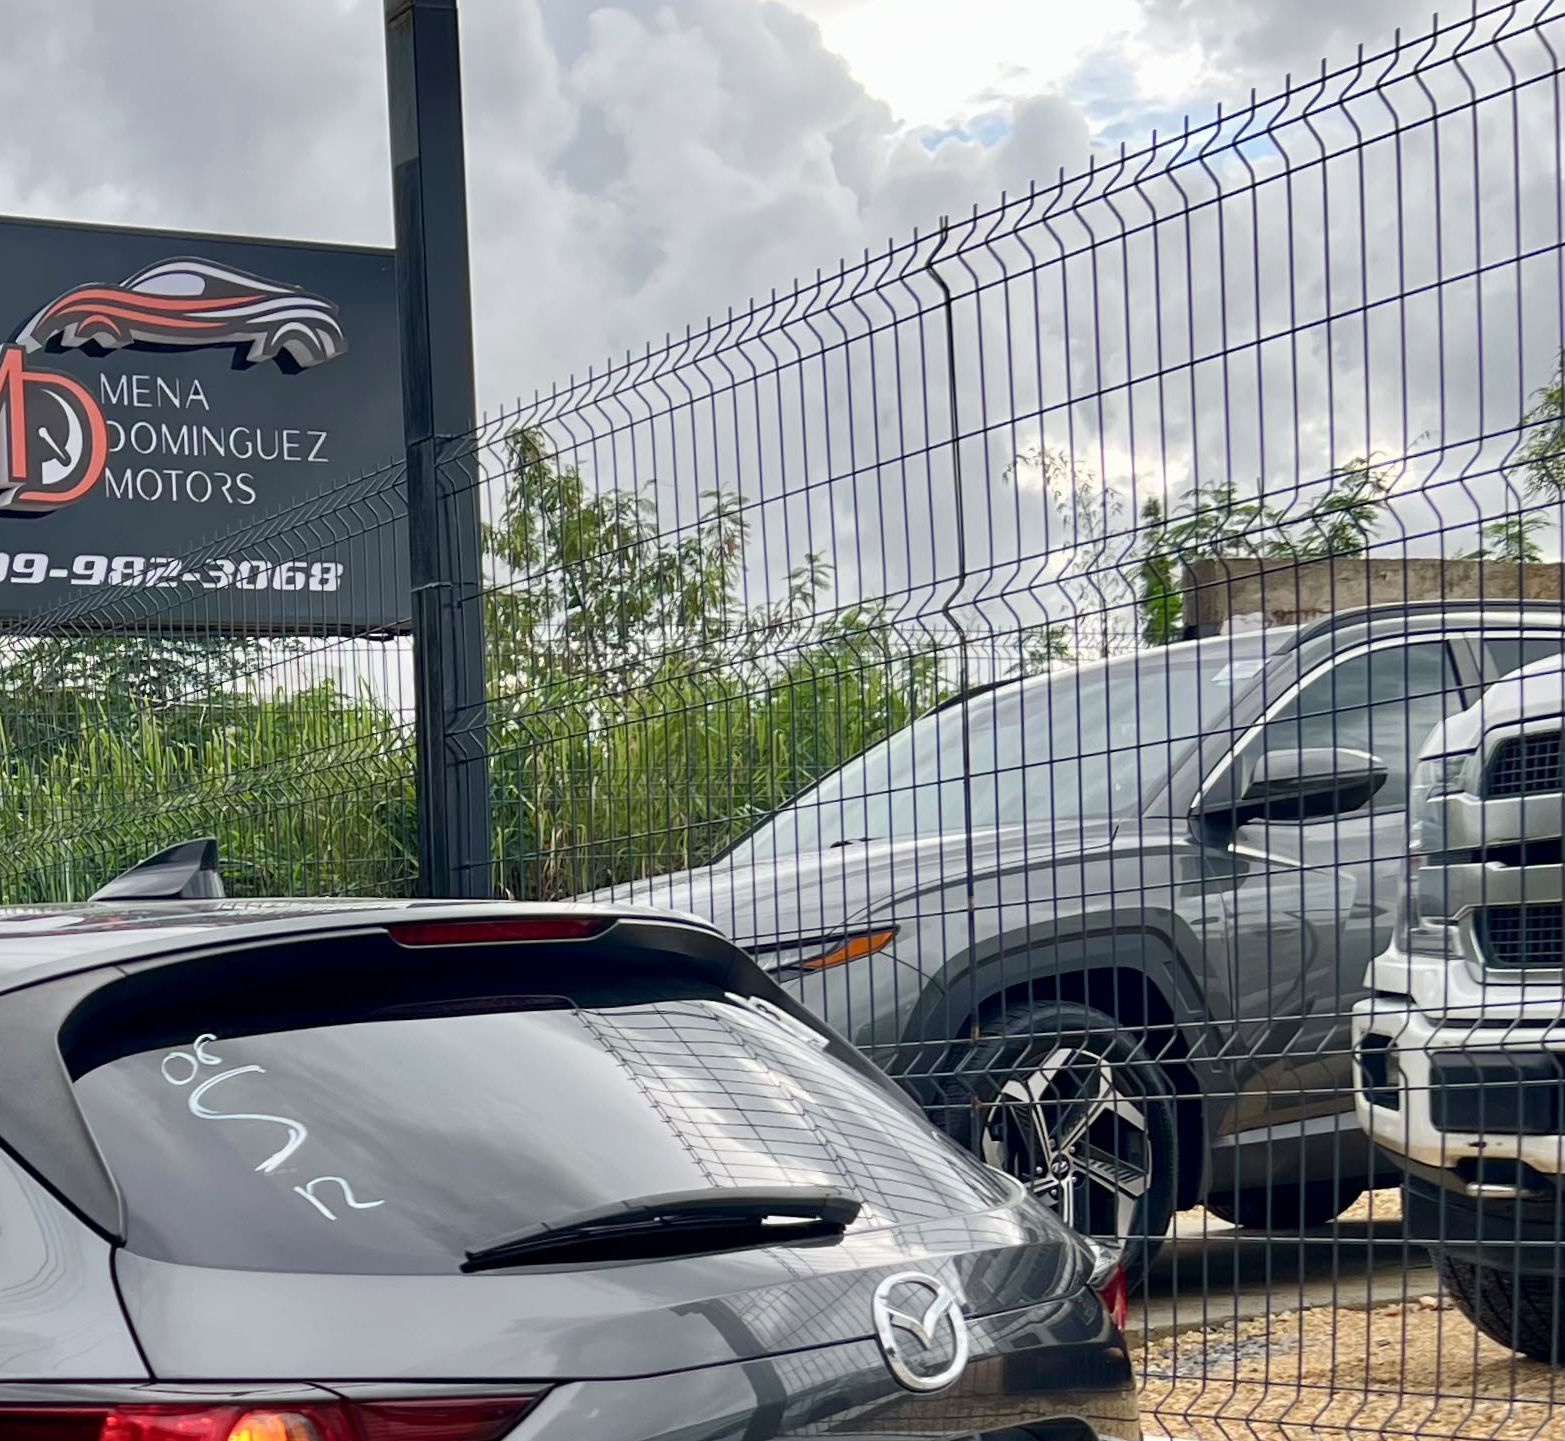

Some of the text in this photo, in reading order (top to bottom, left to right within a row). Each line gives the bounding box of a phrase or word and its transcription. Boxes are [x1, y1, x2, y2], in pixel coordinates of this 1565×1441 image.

[99, 372, 210, 411] MENA
[105, 419, 330, 463] DOMINGUEZ
[104, 466, 257, 505] MOTORS
